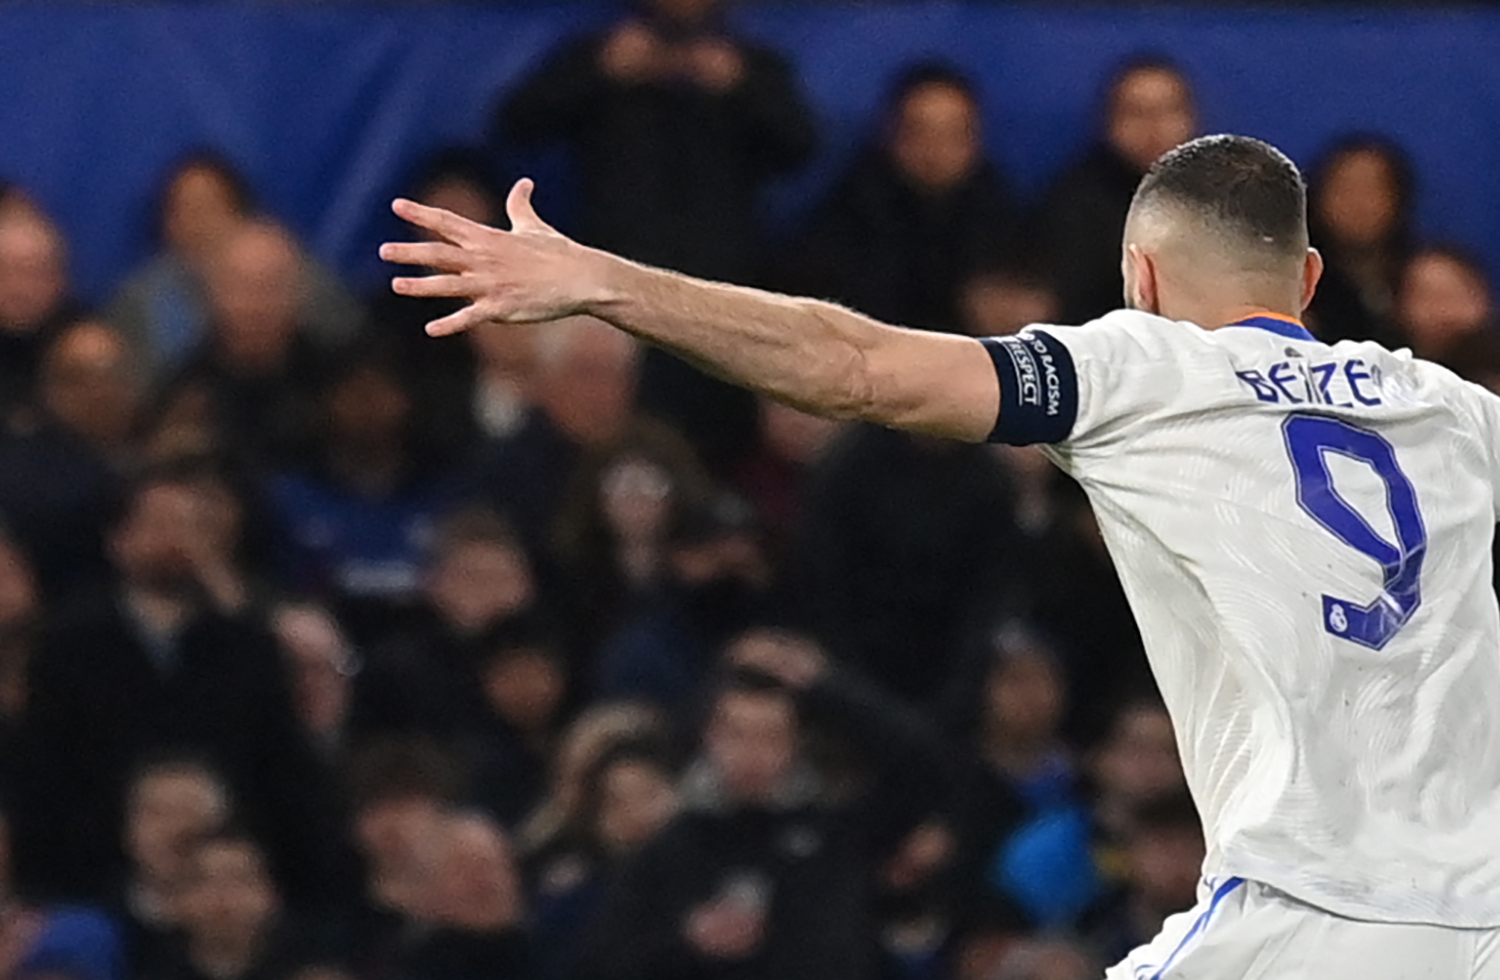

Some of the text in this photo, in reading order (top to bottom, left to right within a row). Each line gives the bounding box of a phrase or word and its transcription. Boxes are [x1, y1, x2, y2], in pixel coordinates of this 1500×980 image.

[1008, 339, 1038, 406] RESPECT
[1040, 354, 1061, 416] RACISM
[1280, 410, 1428, 652] 9
